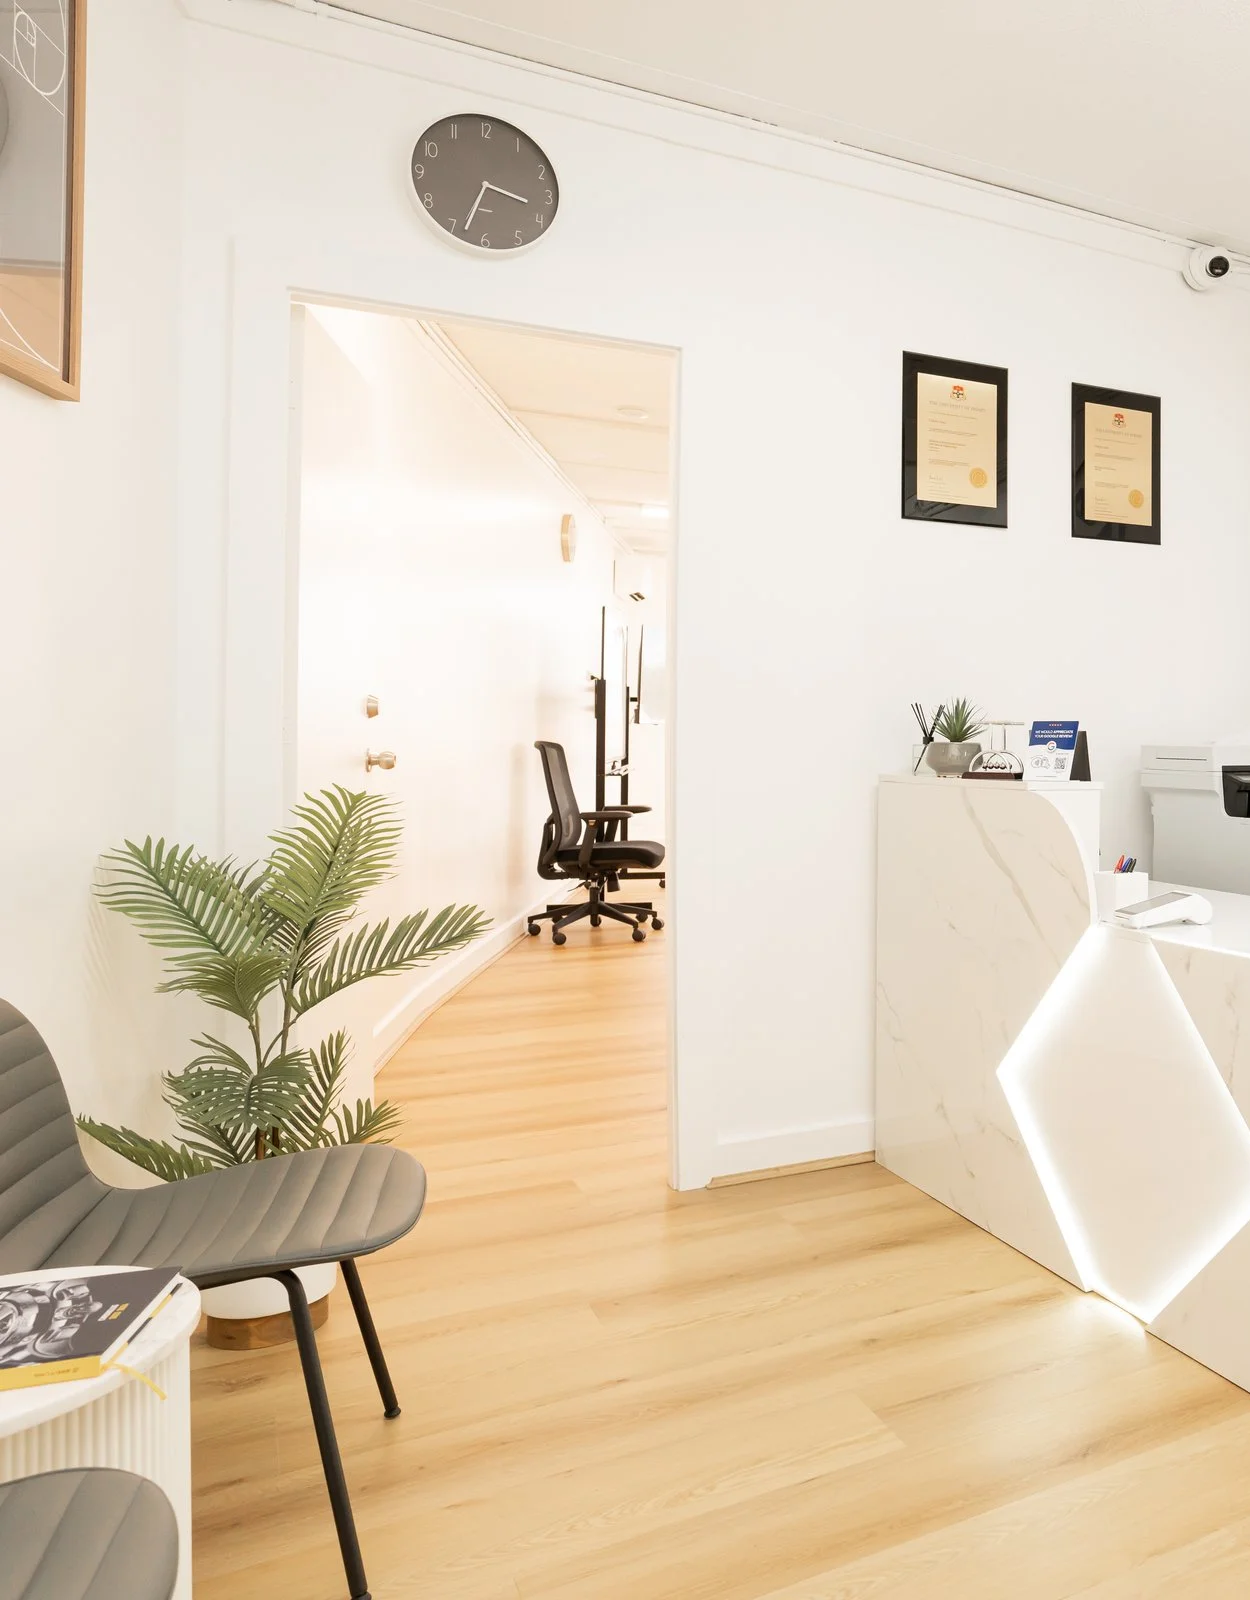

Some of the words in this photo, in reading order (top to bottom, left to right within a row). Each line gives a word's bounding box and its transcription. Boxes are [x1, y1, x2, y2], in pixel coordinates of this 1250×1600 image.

[481, 122, 492, 139] 12
[424, 140, 438, 158] 10
[414, 163, 425, 180] 9
[538, 164, 546, 181] 2
[423, 193, 434, 209] 8
[544, 189, 553, 205] 3
[448, 217, 457, 234] 7
[535, 213, 544, 229] 4
[480, 233, 491, 248] 6
[514, 230, 523, 246] 5
